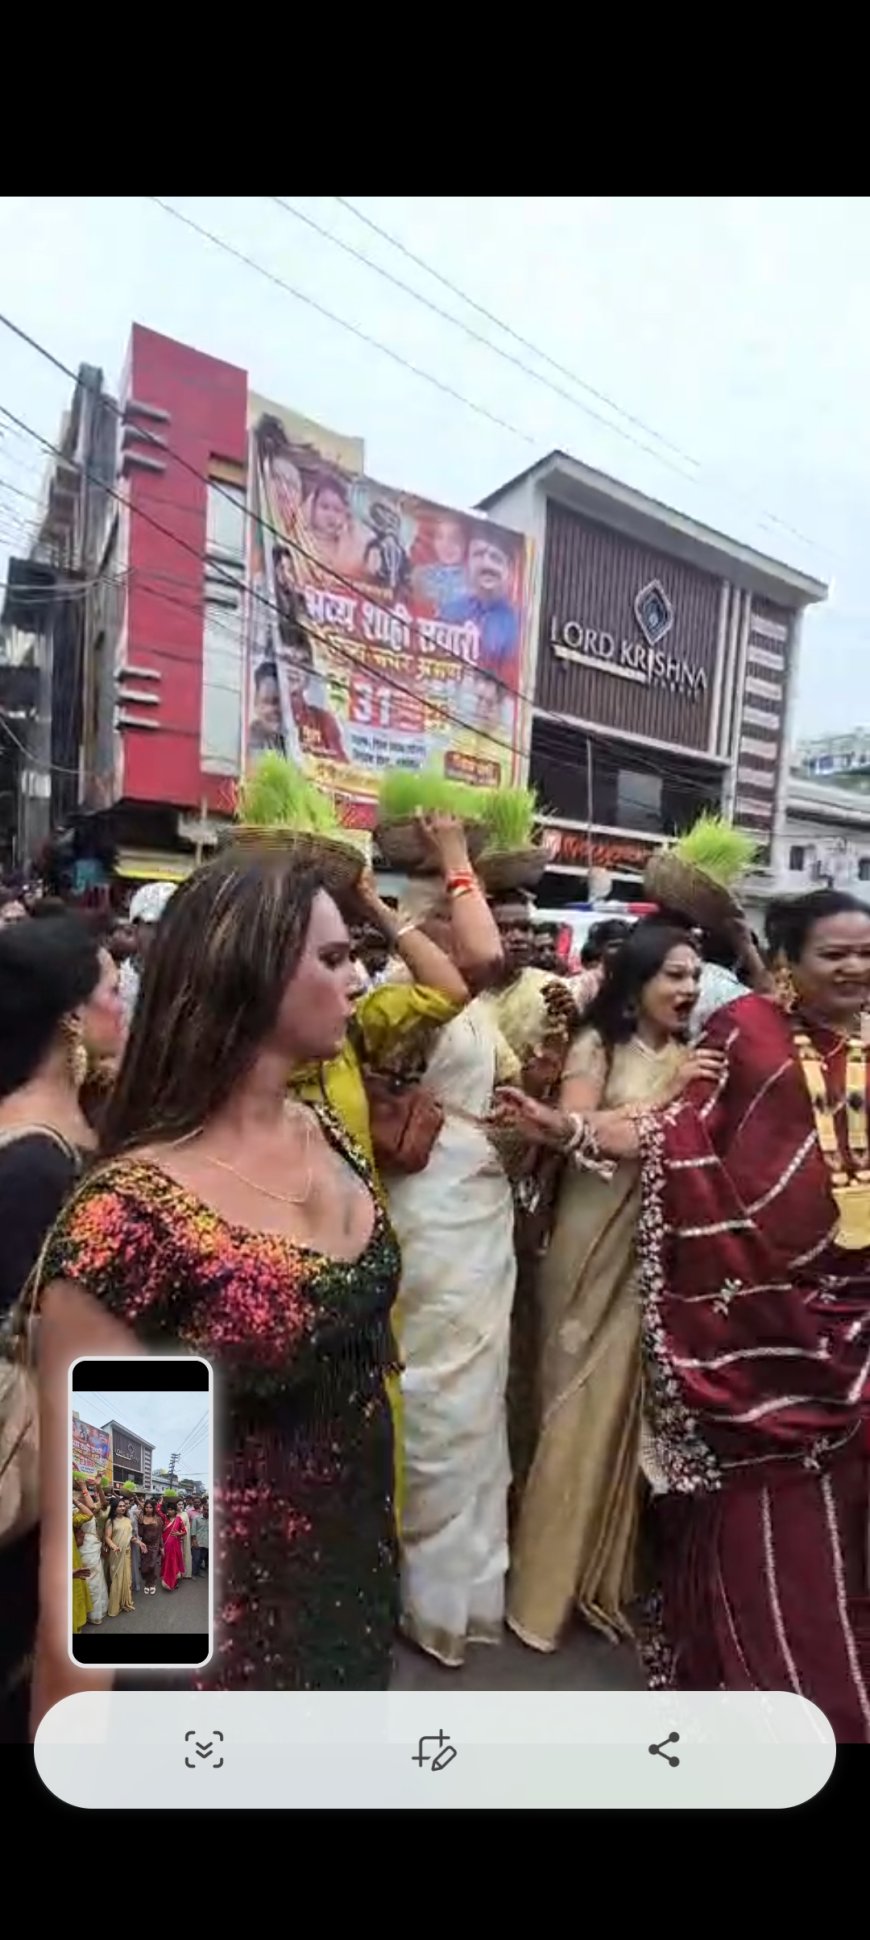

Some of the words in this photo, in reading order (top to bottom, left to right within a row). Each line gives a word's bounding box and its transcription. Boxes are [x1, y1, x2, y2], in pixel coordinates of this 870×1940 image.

[304, 584, 358, 632] भव्य
[361, 602, 413, 651] शाही
[415, 616, 481, 667] सवारी
[551, 615, 615, 659] LORD
[620, 639, 708, 690] KRISHNA
[352, 680, 394, 728] 31
